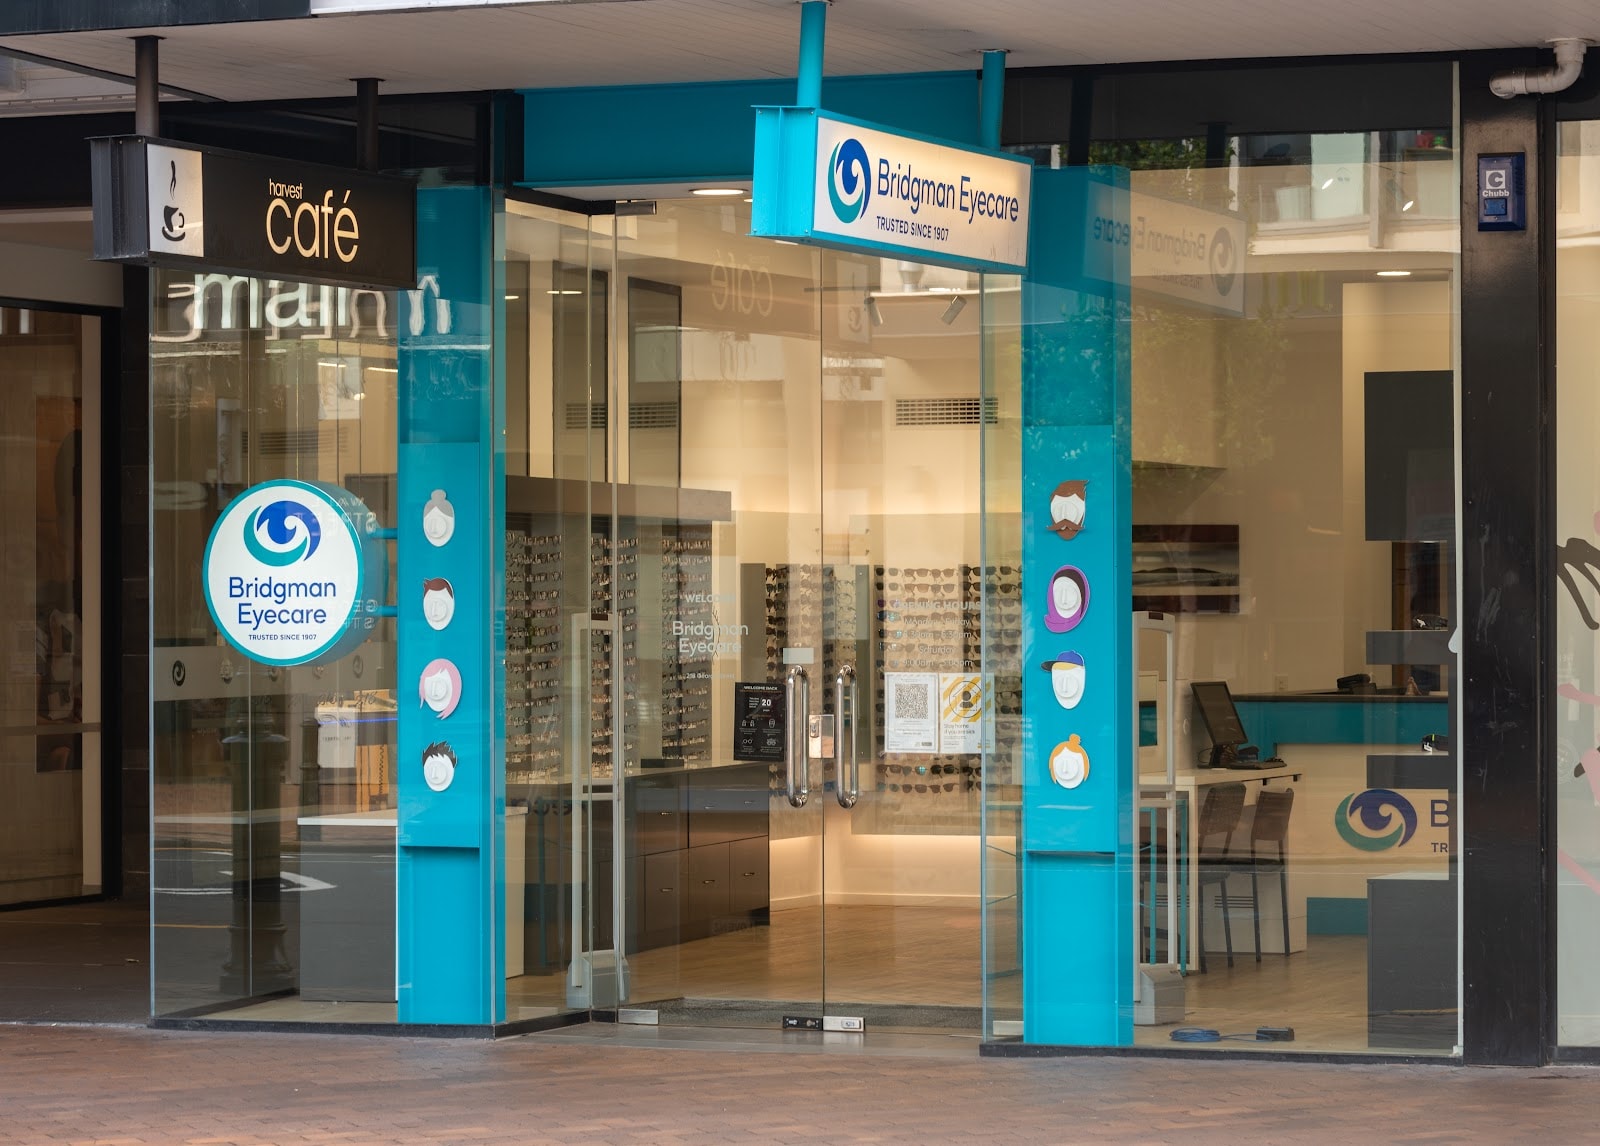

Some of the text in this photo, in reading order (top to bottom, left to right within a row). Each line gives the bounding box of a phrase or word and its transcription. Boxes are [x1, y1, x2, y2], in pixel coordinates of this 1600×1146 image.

[269, 178, 303, 199] harvest
[877, 158, 1019, 224] Bridgman Eyecare
[1482, 190, 1510, 198] Chubb
[266, 189, 359, 263] café
[876, 215, 949, 241] TRUSTED SINCE 1907
[229, 576, 337, 605] Bridgman
[943, 601, 981, 610] HOURS
[238, 602, 327, 631] Eyecare
[672, 620, 749, 640] Bridgman
[679, 637, 743, 657] Eyecare
[761, 698, 771, 706] 20
